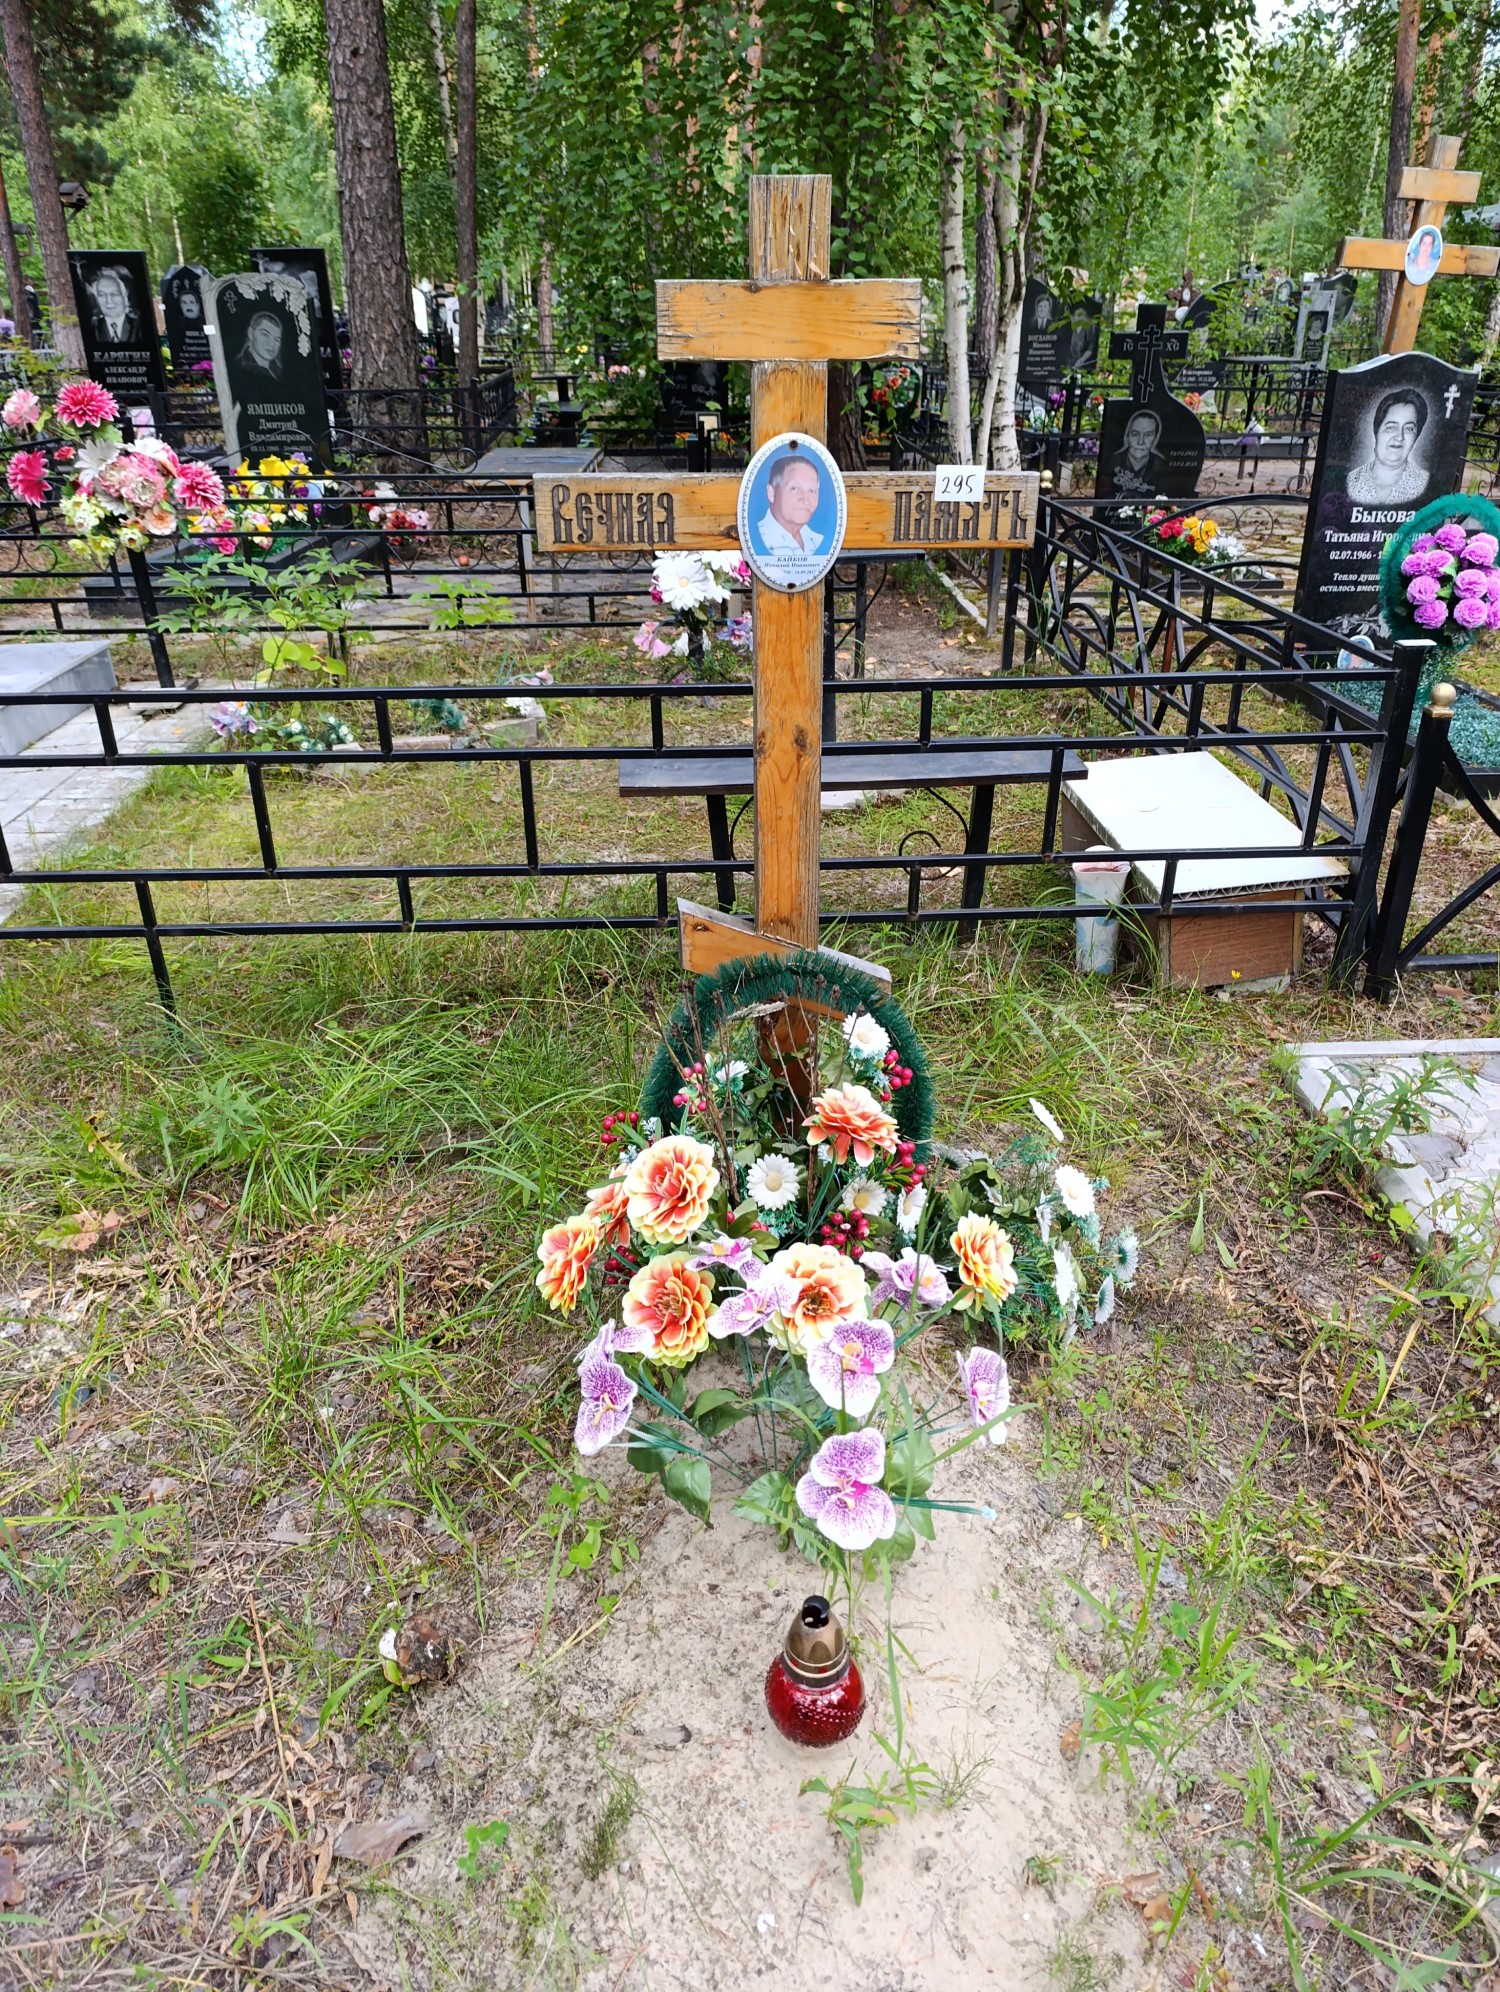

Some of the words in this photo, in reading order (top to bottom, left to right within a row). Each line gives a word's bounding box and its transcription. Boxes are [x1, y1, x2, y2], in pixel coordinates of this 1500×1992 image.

[93, 352, 151, 362] КАРЯГИН
[106, 376, 147, 384] ИВАНОВИЧ
[247, 404, 306, 416] ЯМЩИКОВ
[258, 419, 297, 431] Дмитрий
[942, 474, 976, 494] 295
[1350, 507, 1416, 523] Быкова
[1325, 530, 1370, 543] Татьяна
[1329, 551, 1371, 559] 02.07.1966
[1333, 573, 1357, 581] Тепло
